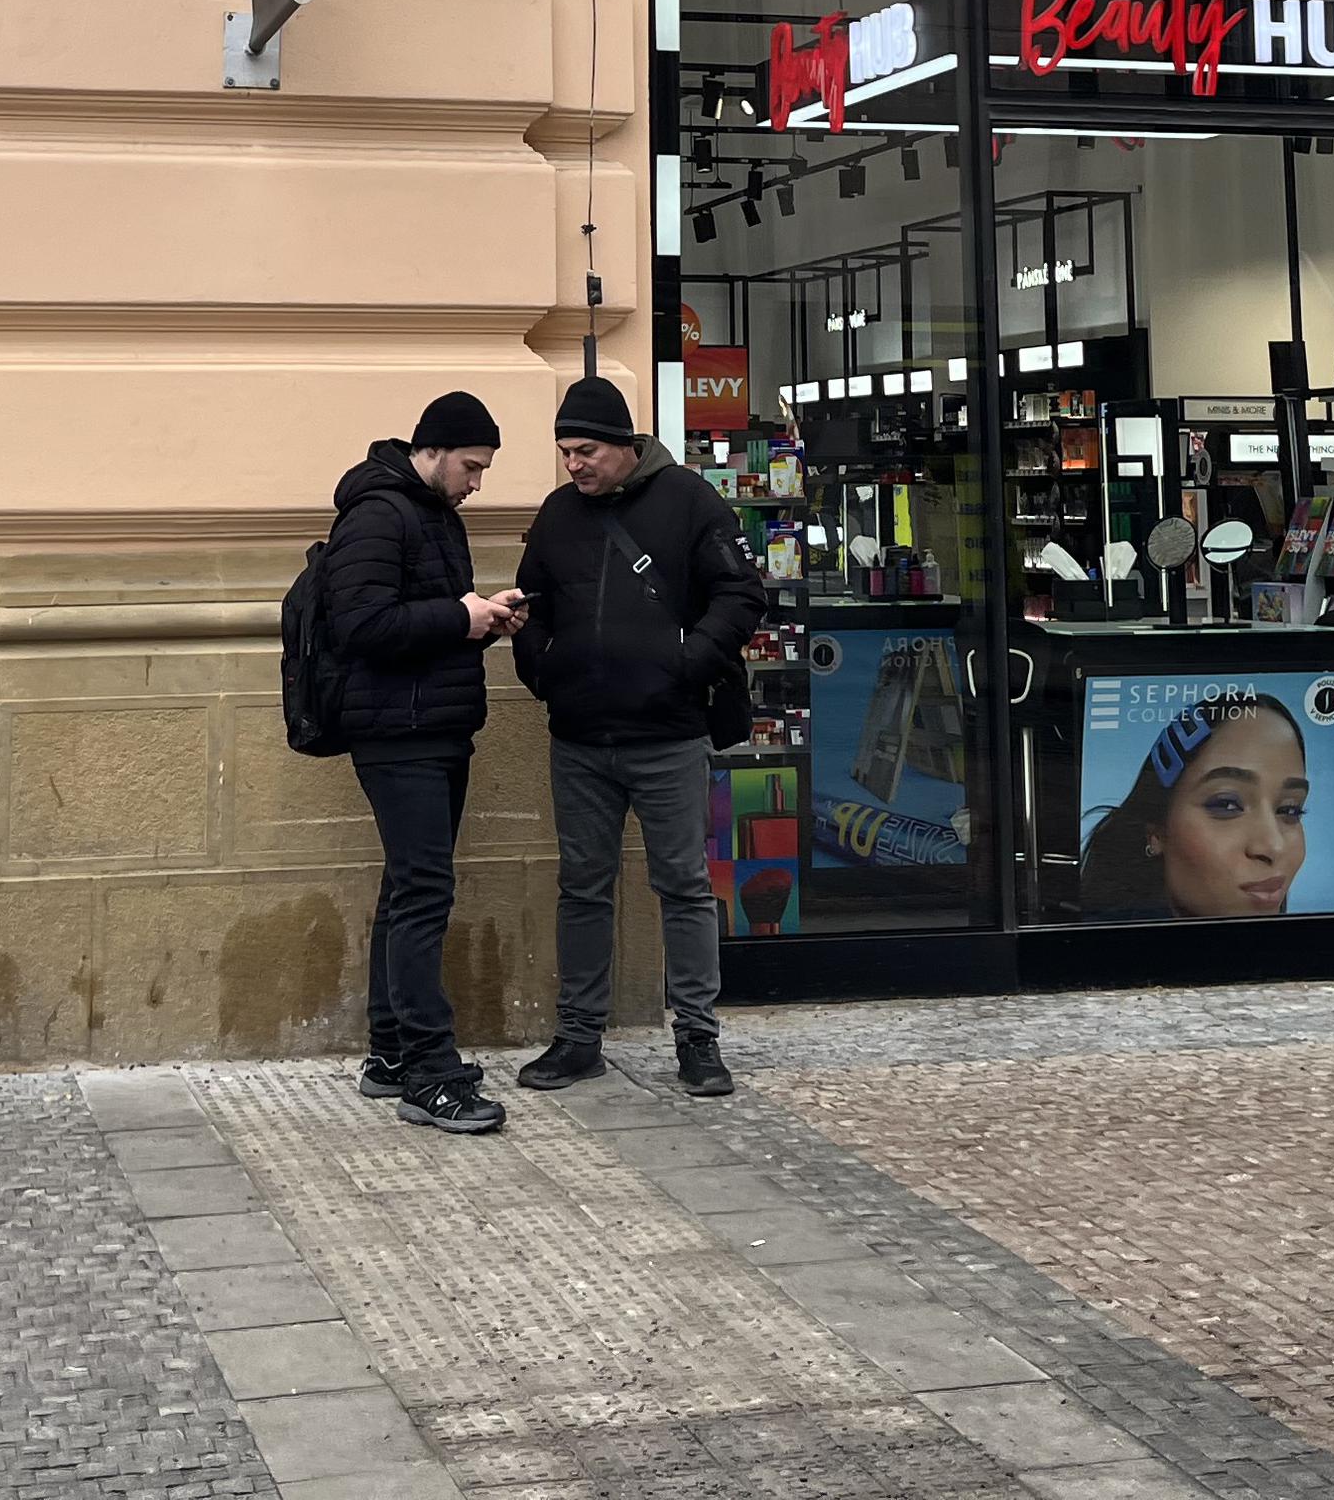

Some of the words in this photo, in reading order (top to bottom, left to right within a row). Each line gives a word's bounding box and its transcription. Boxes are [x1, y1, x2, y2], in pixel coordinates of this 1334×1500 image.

[686, 377, 744, 398] LEVY
[1241, 406, 1267, 415] MORE
[1248, 444, 1264, 454] THE
[1130, 682, 1258, 704] SEPHORA
[1127, 705, 1258, 723] COLLECTION
